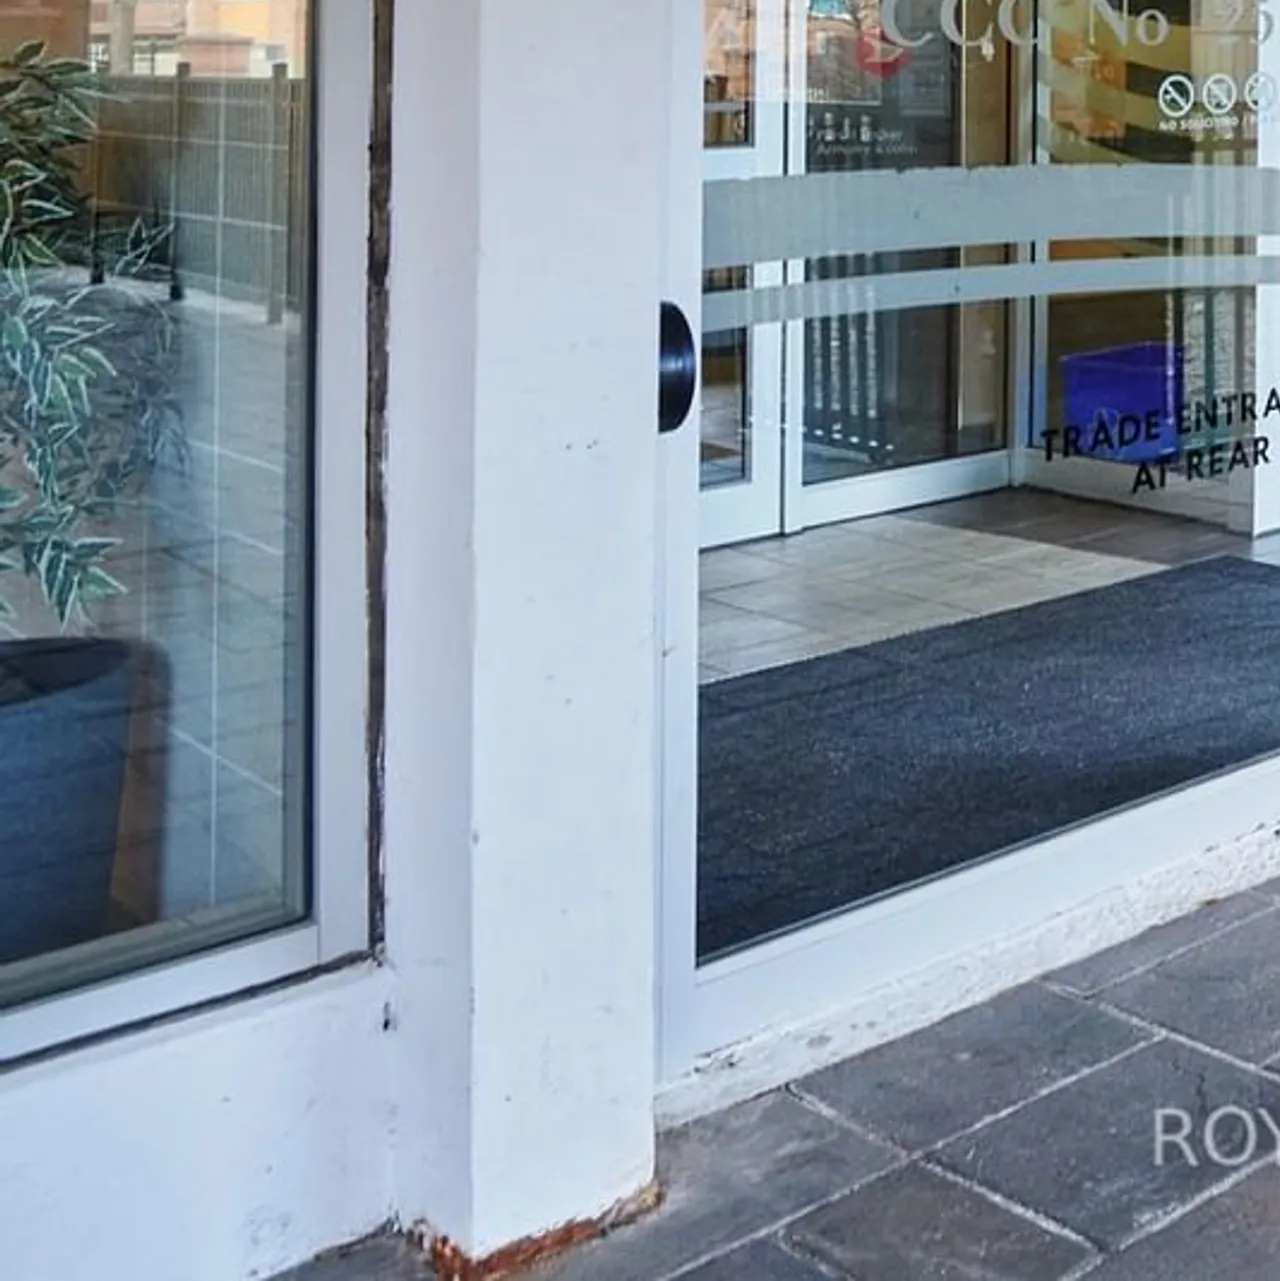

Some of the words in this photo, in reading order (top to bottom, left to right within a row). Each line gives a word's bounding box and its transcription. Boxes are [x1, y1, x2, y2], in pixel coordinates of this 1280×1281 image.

[1040, 409, 1162, 463] TRADE
[1131, 459, 1171, 494] AT
[1186, 436, 1270, 482] REAR
